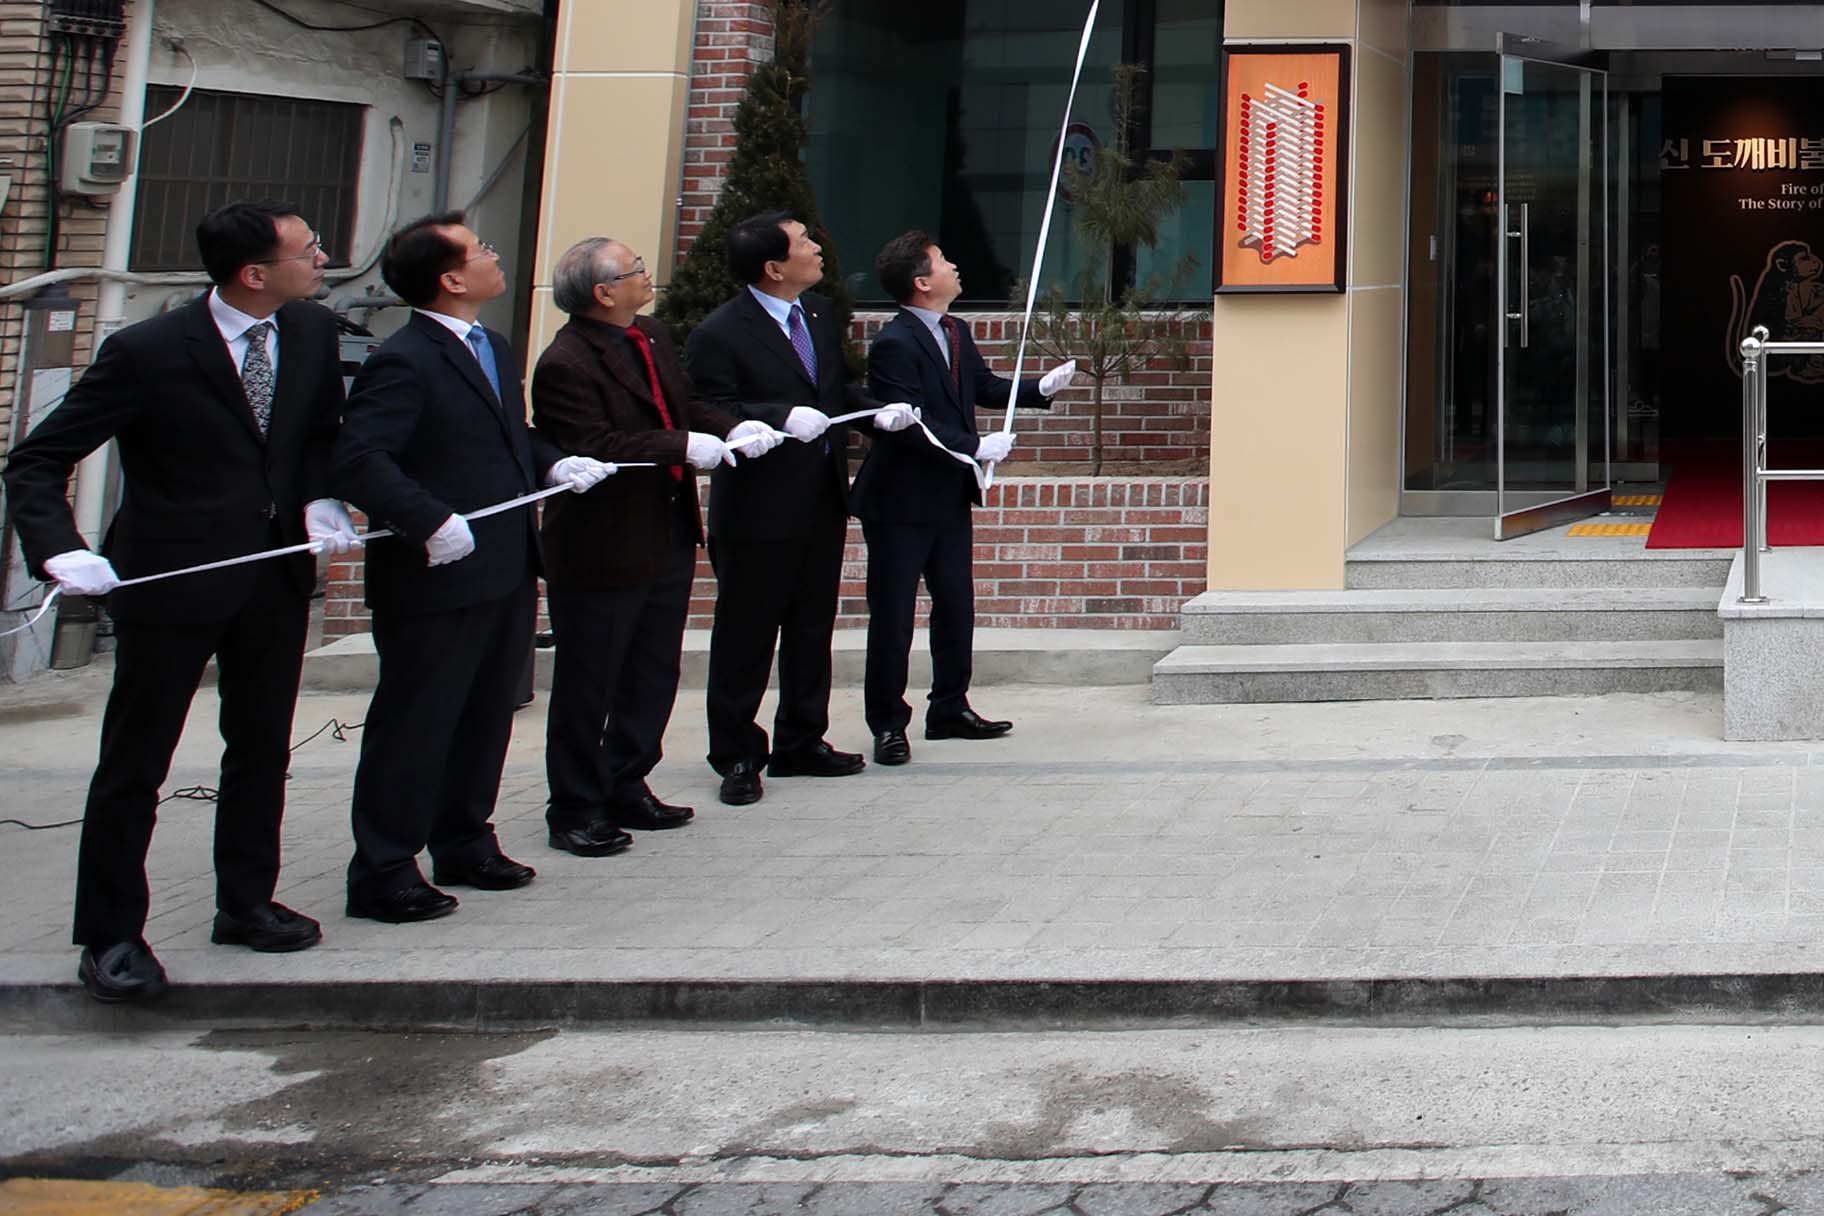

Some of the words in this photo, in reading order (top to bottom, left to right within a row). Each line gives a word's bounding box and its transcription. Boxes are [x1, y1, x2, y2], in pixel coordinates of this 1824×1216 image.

[1780, 183, 1808, 196] Fire
[1738, 198, 1765, 211] The
[1768, 197, 1803, 213] Story
[1808, 197, 1824, 211] of
